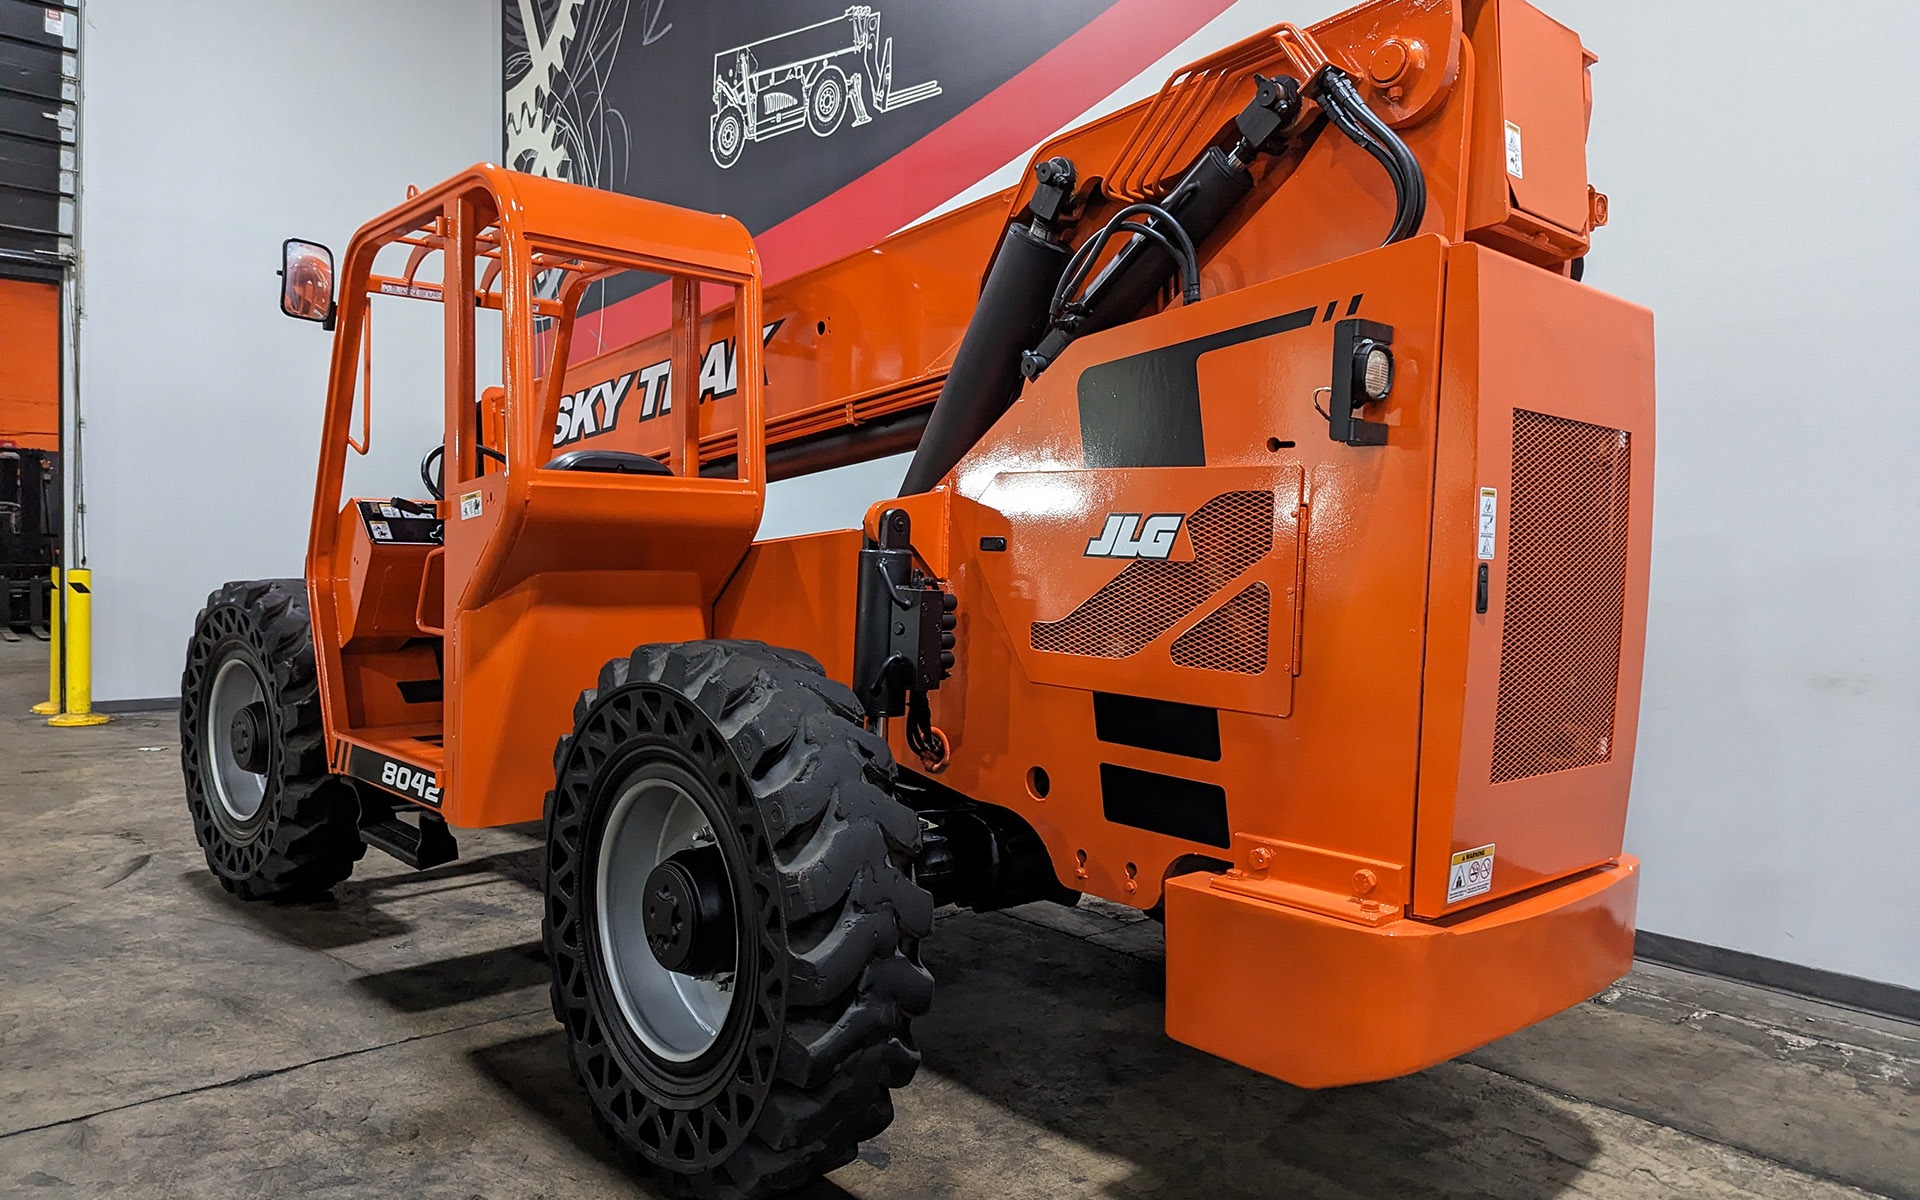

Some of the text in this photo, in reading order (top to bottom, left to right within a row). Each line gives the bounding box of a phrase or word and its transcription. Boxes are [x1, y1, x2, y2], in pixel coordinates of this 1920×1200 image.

[553, 370, 638, 447] SKY
[1083, 512, 1186, 560] JLG
[381, 761, 440, 803] 8042
